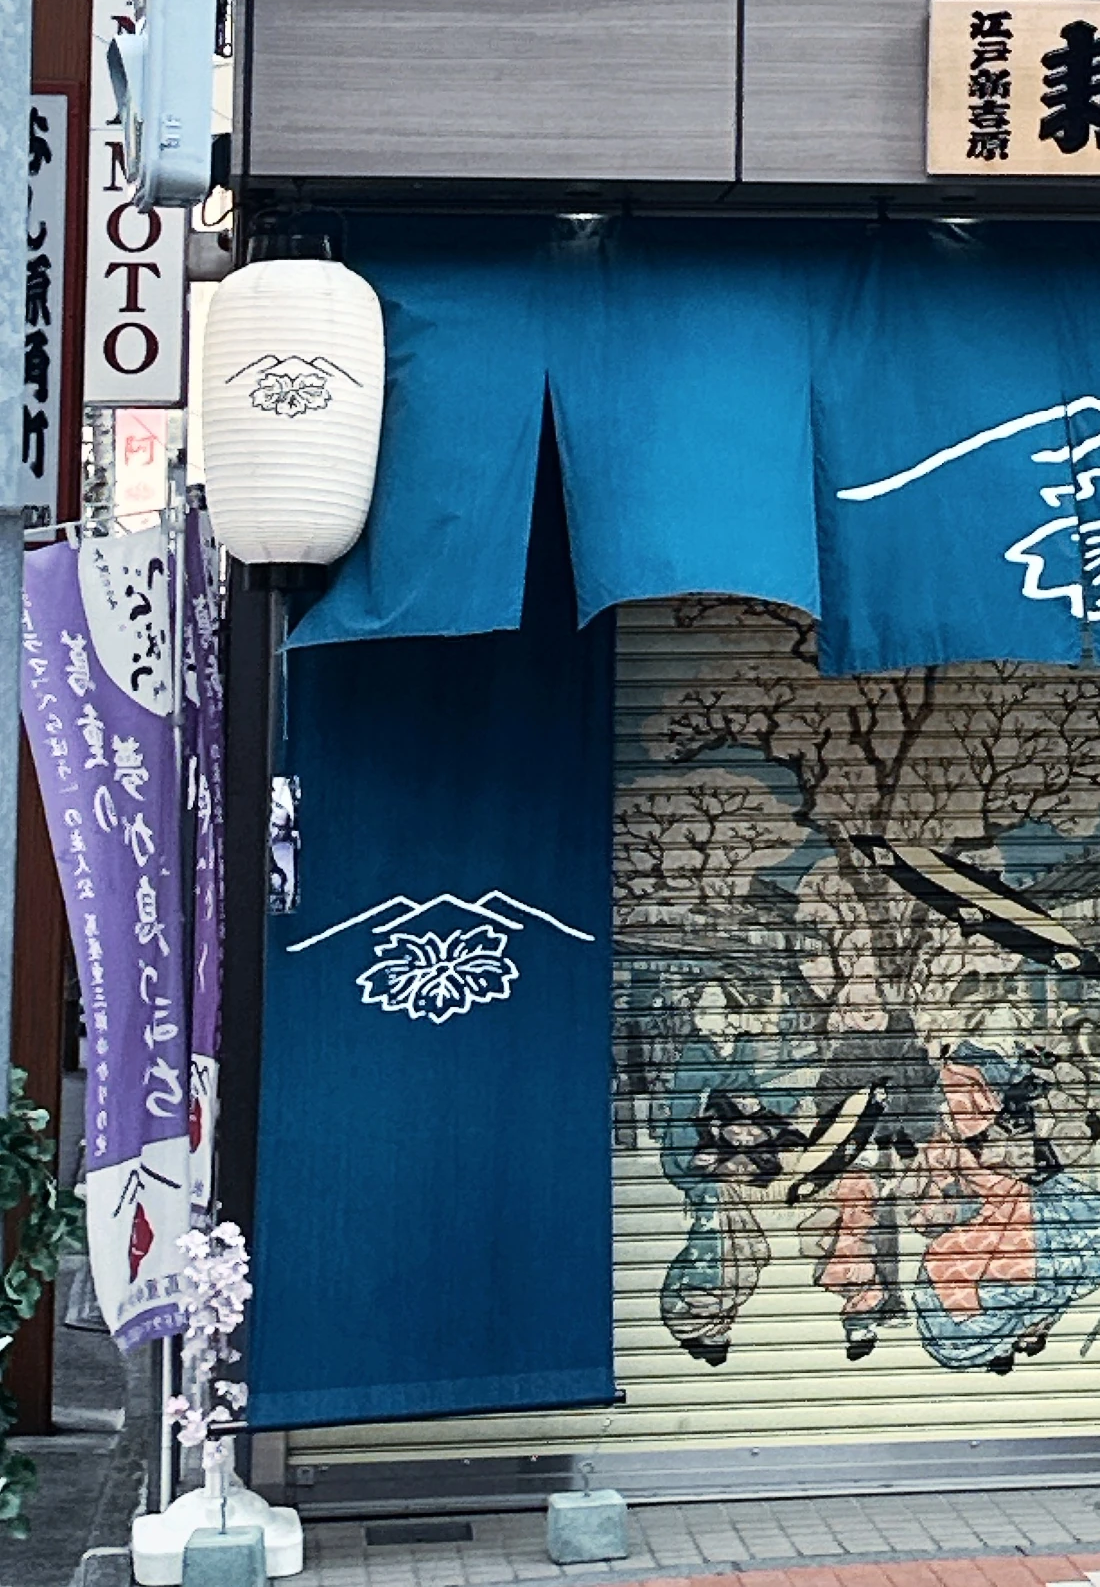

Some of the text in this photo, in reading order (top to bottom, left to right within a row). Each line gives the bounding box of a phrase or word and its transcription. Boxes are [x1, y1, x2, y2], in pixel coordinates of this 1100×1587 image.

[967, 10, 1013, 161] 江戸新吉原
